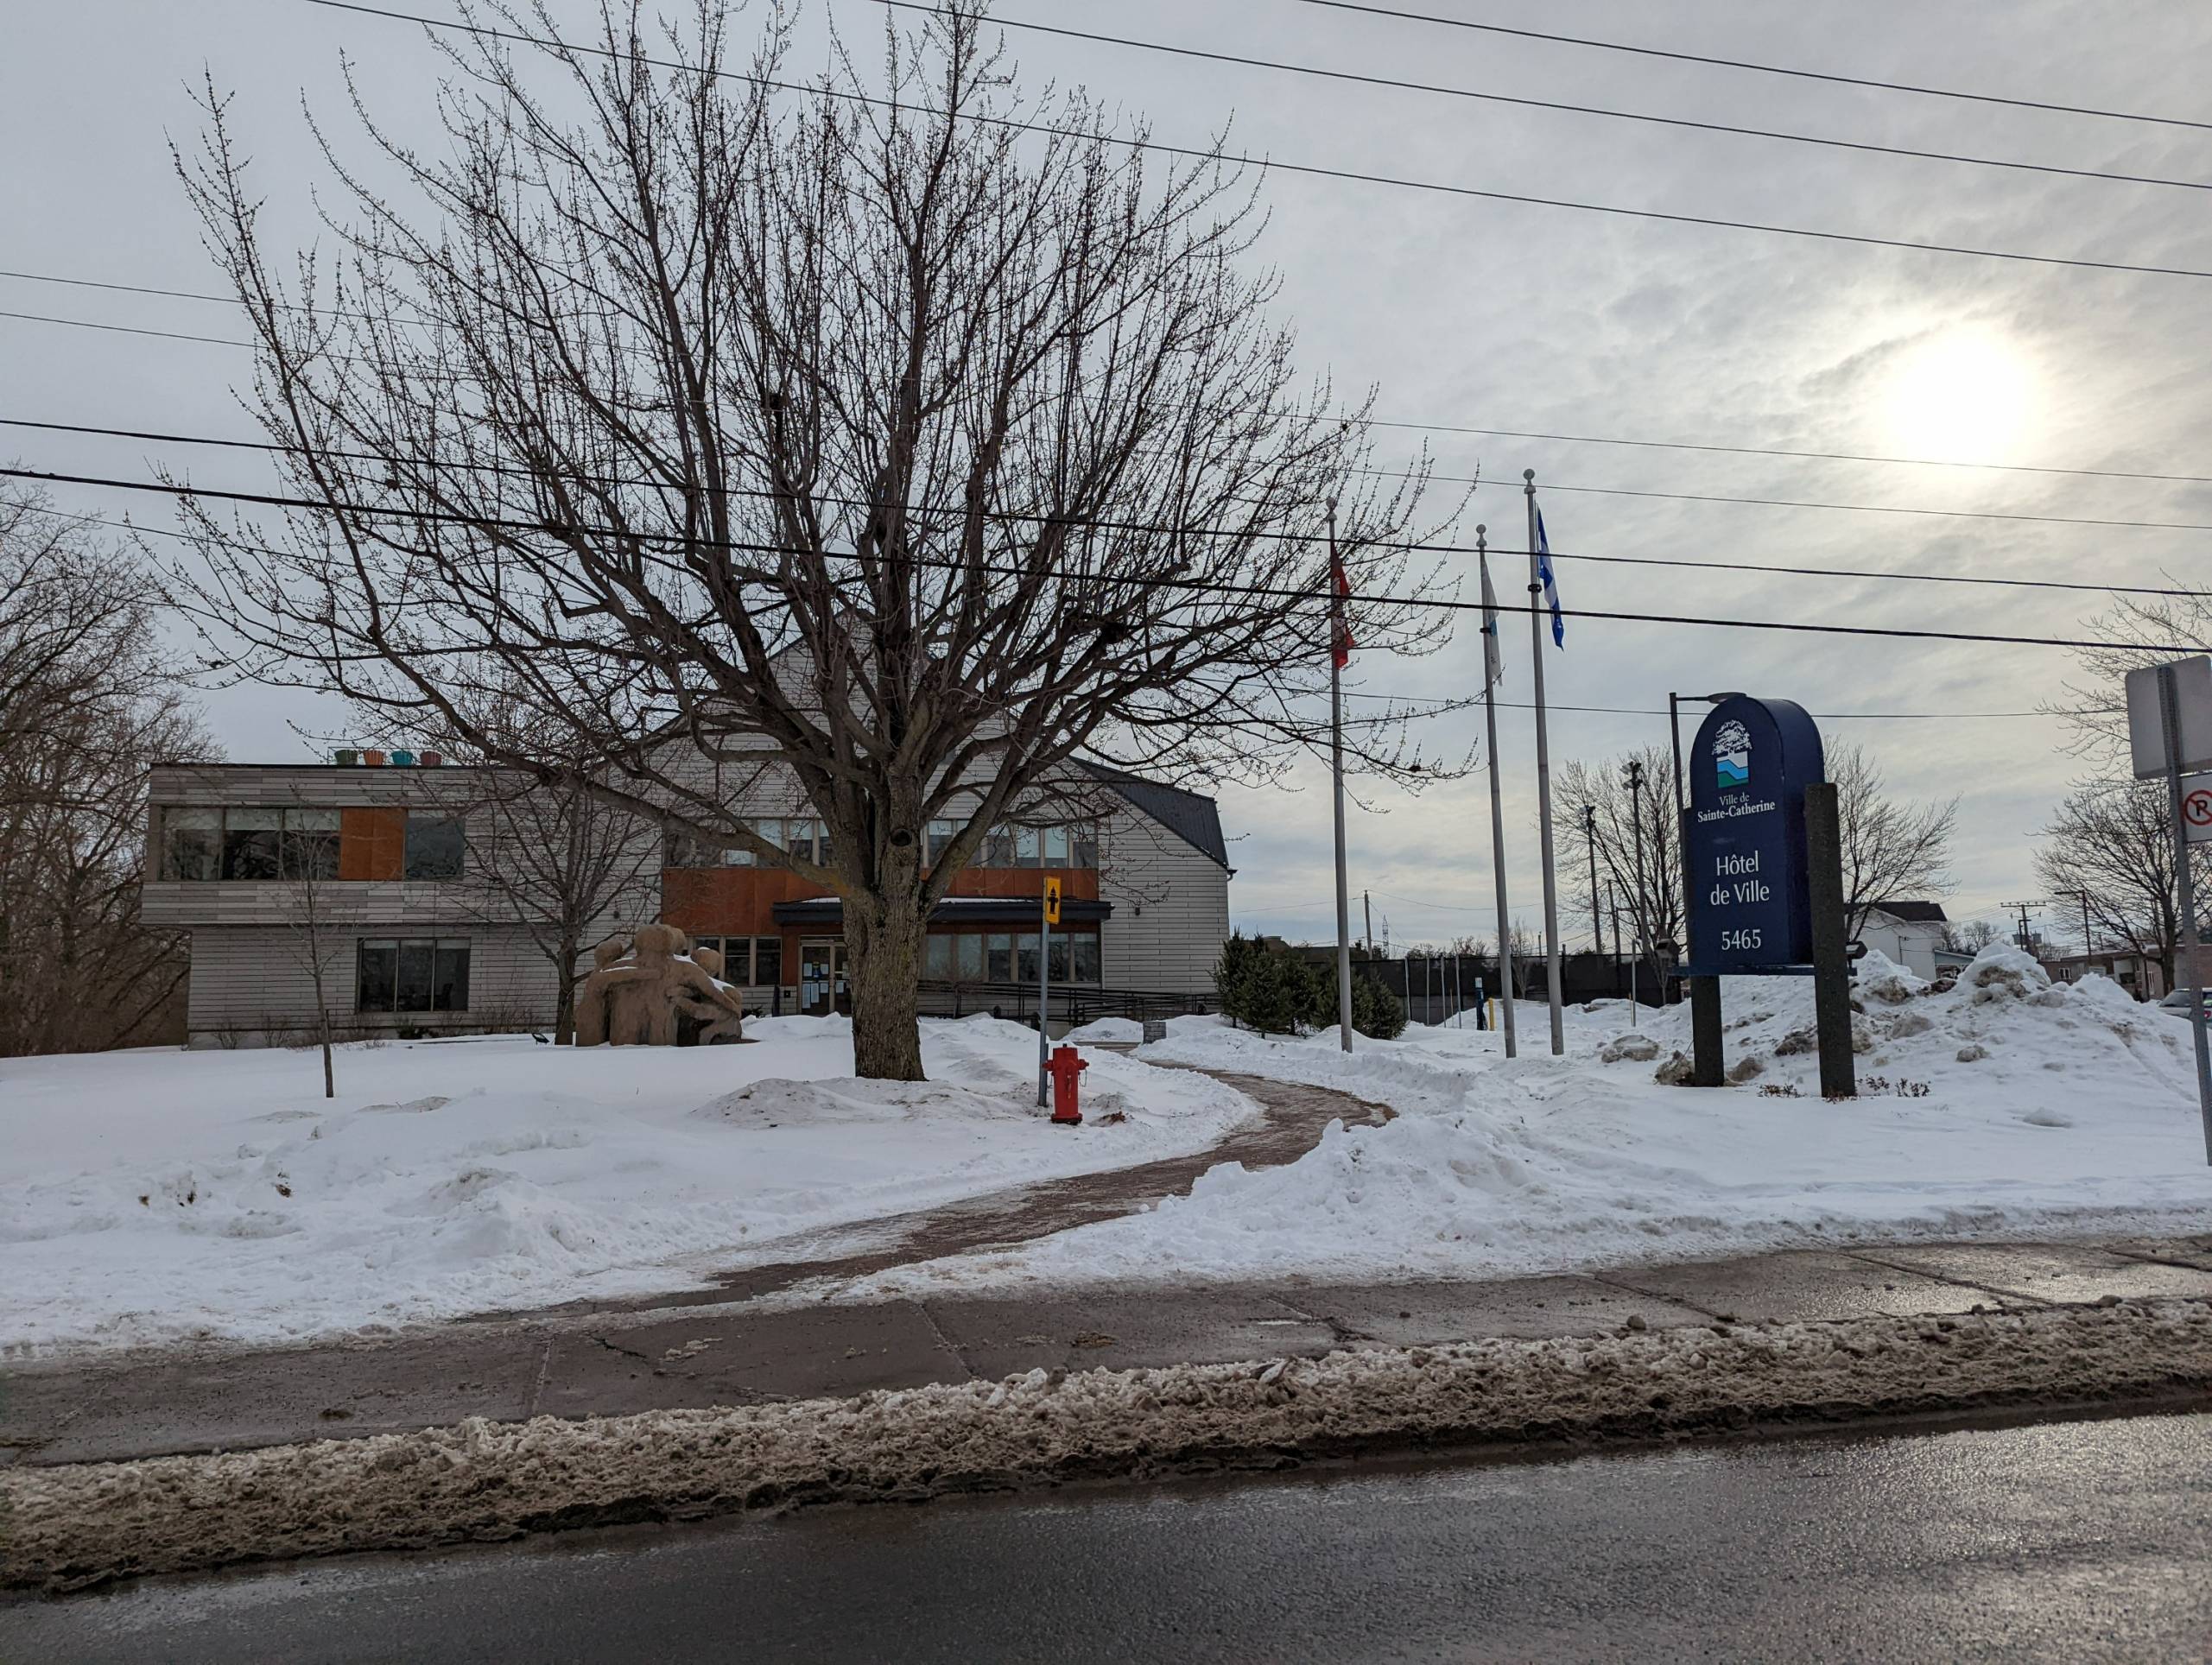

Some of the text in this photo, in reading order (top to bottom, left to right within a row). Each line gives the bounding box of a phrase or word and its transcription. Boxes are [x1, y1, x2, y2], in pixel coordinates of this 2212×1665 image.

[1719, 791, 1750, 807] Ville de
[1697, 800, 1776, 823] Sainte-Catherine
[1716, 850, 1759, 877] Hôtel
[1710, 879, 1770, 906] de Ville
[1721, 928, 1762, 951] 5465
